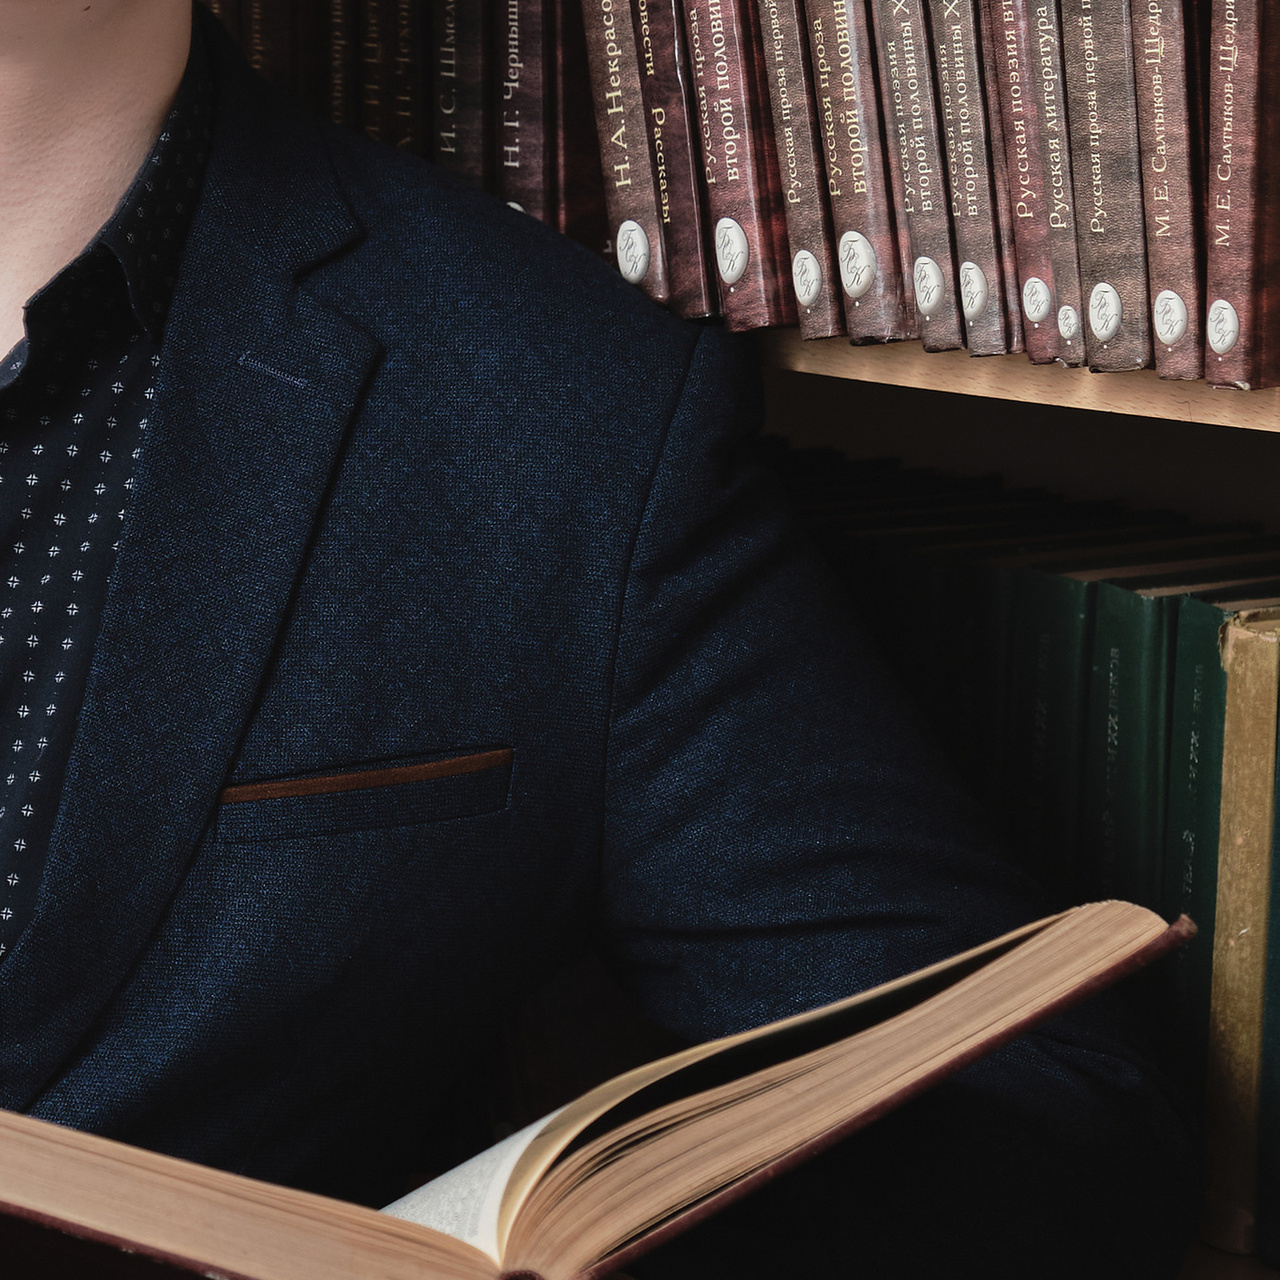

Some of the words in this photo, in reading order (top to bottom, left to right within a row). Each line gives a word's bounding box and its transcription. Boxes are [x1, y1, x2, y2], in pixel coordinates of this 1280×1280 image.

[330, 31, 347, 123] ольклор
[689, 8, 706, 77] проза
[813, 17, 831, 87] проза
[887, 41, 903, 117] поэзия
[901, 21, 923, 131] половины
[952, 24, 971, 135] половины
[1005, 29, 1023, 113] поэзия
[1036, 5, 1058, 131] литература
[1079, 15, 1098, 84] первой
[440, 88, 456, 115] С.
[503, 110, 520, 128] Г.
[778, 68, 793, 121] проза
[939, 44, 954, 120] поэзия
[1087, 90, 1102, 147] проза
[440, 124, 456, 153] И.
[503, 137, 520, 168] Н.
[652, 107, 670, 223] Рассказы
[699, 85, 716, 184] Русская
[714, 98, 740, 181] второй
[784, 127, 801, 204] Русская
[823, 97, 841, 196] Русская
[839, 109, 867, 194] второй
[898, 123, 916, 213] Русская
[947, 126, 962, 217] Русская
[1014, 120, 1036, 218] Русская
[909, 136, 933, 212] второй
[957, 140, 978, 217] второй
[1048, 139, 1069, 229] Русская
[1090, 152, 1107, 233] Русская
[1153, 179, 1169, 202] Е.
[1216, 189, 1231, 211] Е.
[1155, 208, 1171, 238] М.
[1214, 218, 1230, 247] М.
